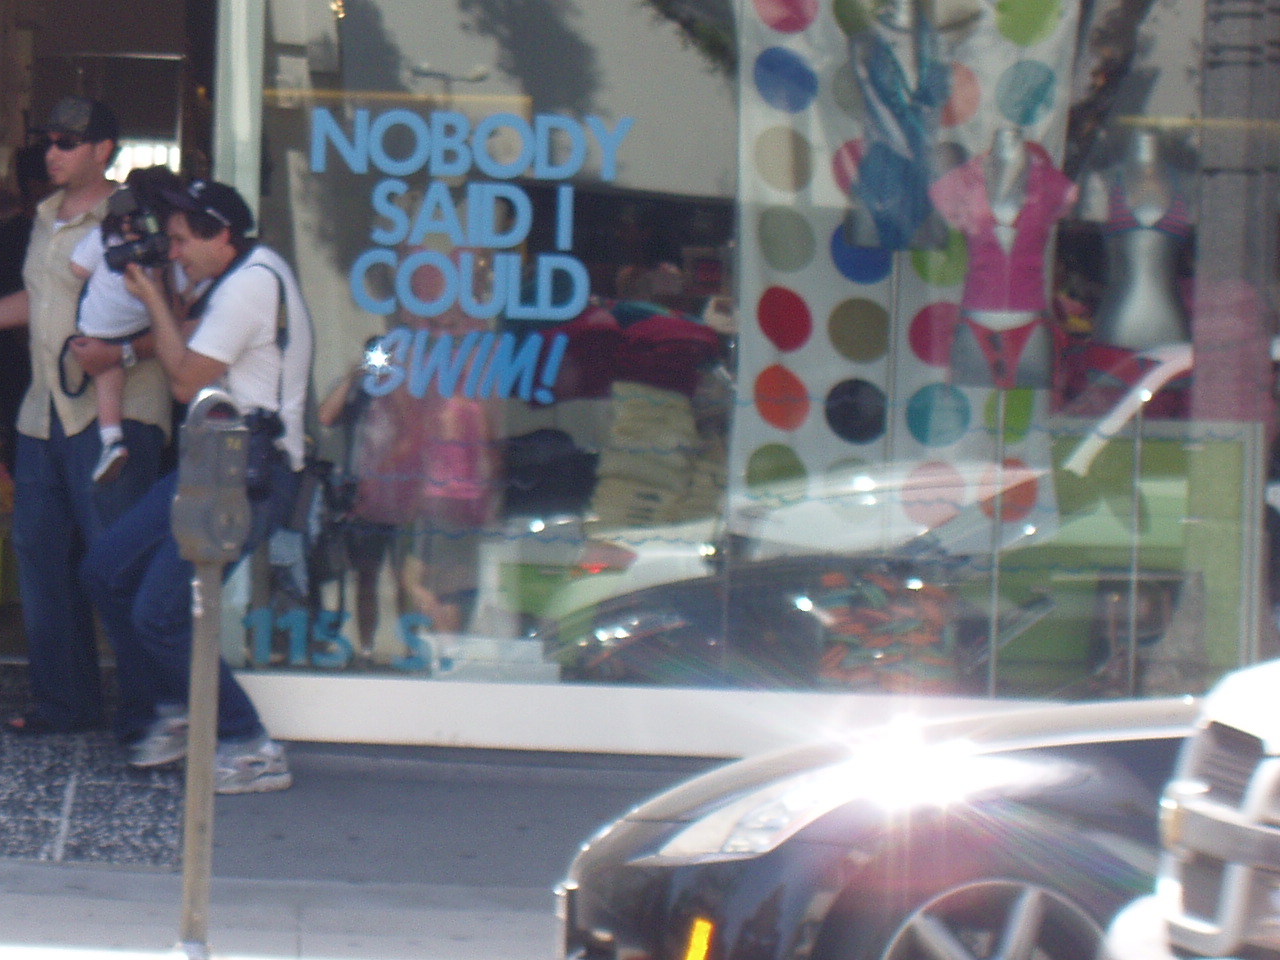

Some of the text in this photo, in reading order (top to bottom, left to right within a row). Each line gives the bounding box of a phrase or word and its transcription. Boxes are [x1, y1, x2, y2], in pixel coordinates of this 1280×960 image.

[310, 106, 636, 182] NOBODY
[370, 177, 575, 252] SAID I
[350, 248, 591, 321] COULD
[361, 326, 569, 405] SWIM!
[242, 608, 354, 668] 115
